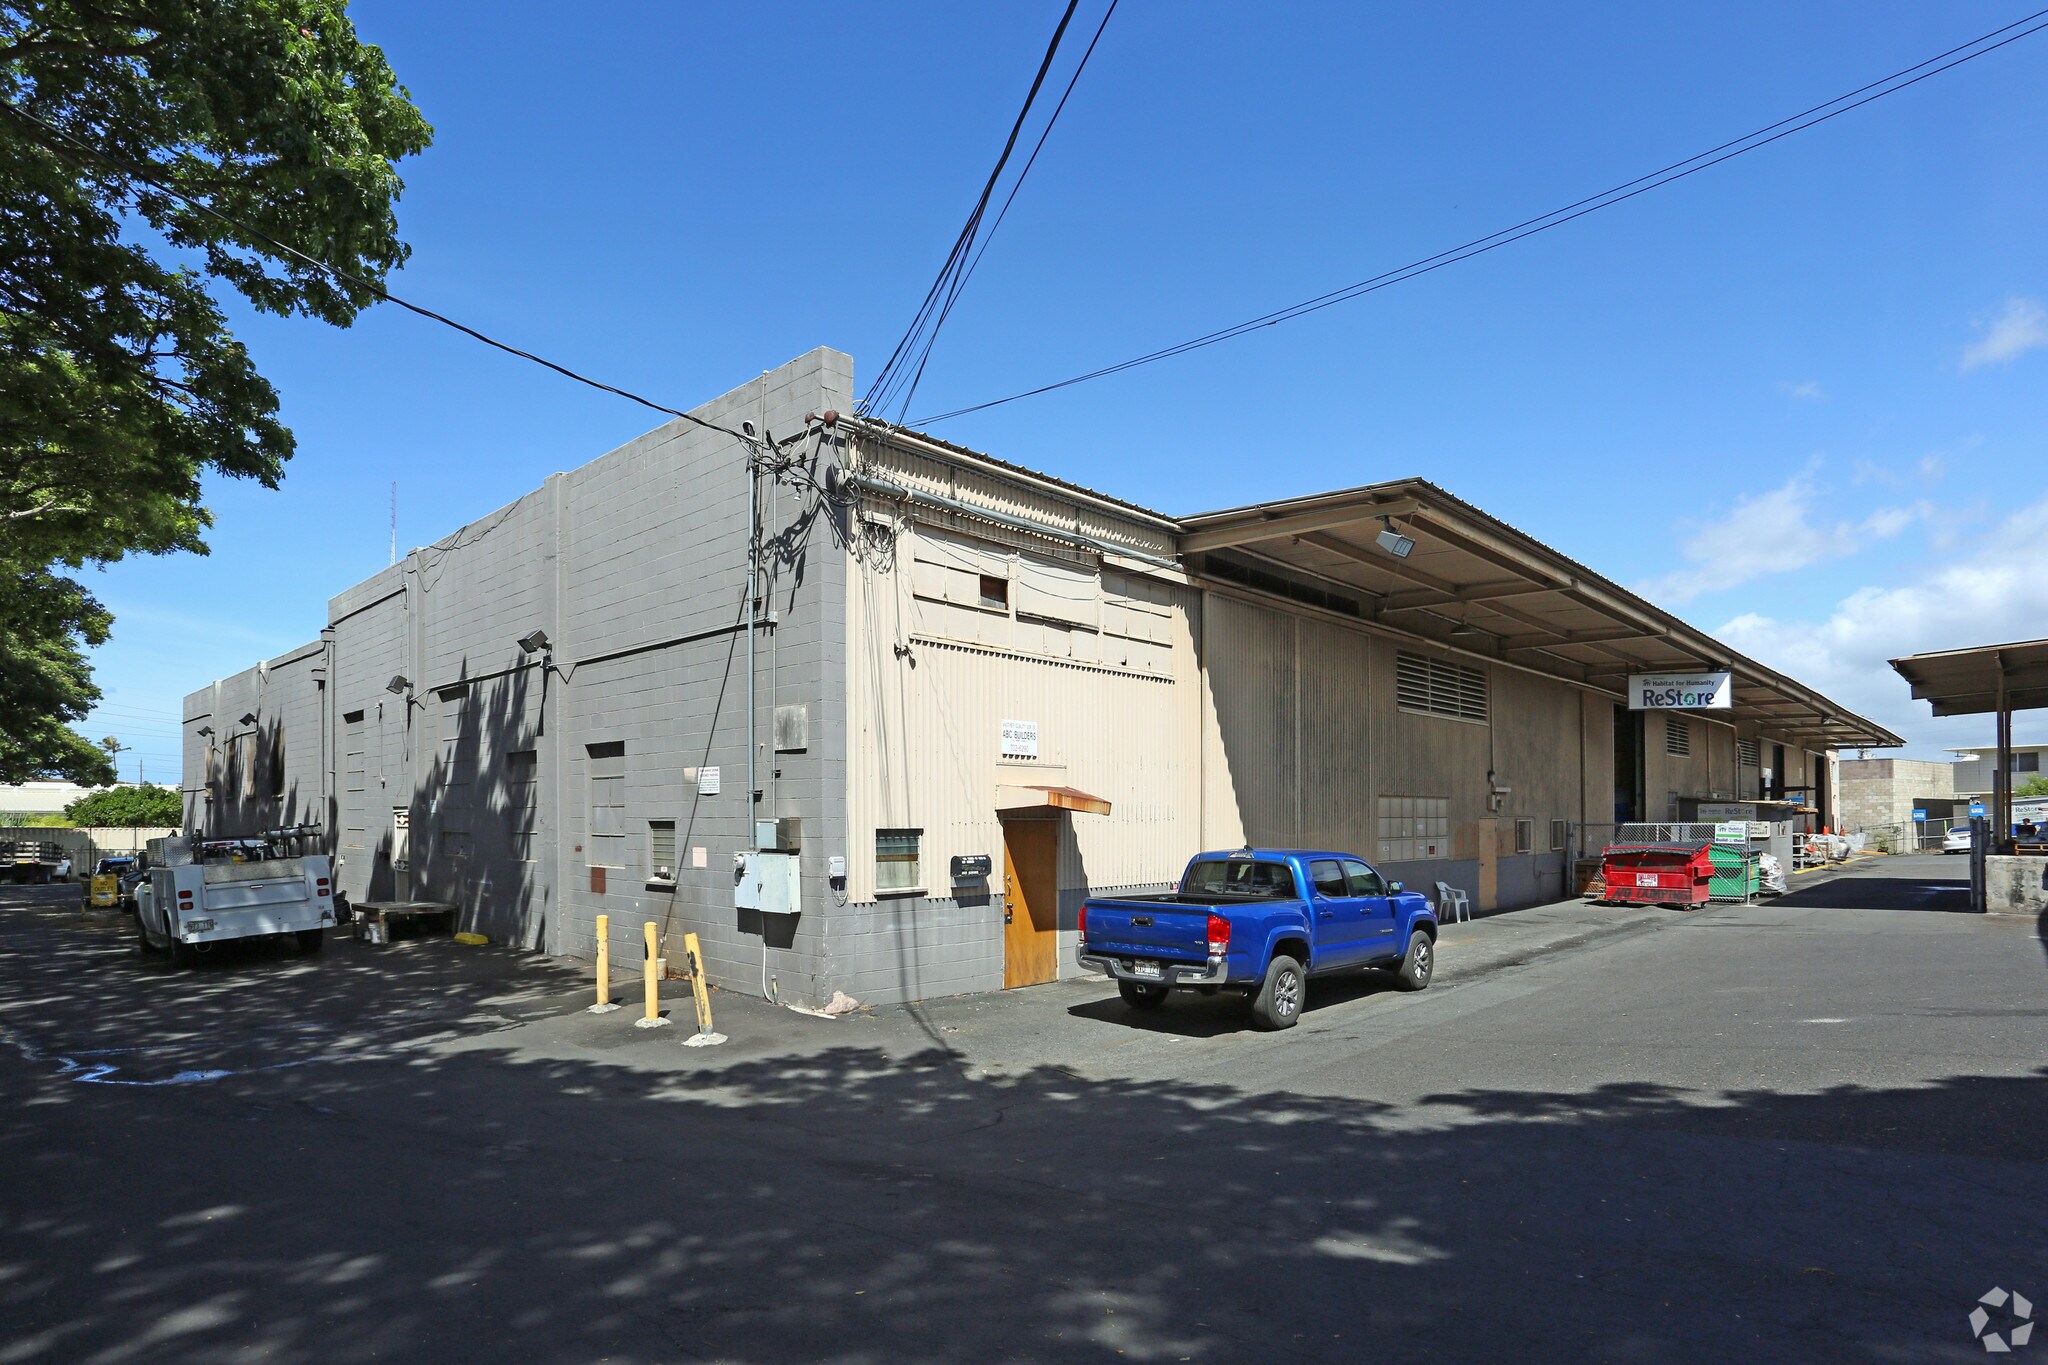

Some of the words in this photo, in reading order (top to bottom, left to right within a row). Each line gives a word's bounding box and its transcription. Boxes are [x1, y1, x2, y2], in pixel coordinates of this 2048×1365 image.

[1652, 679, 1674, 687] Habitat
[1686, 679, 1715, 687] Humanity
[1642, 688, 1715, 707] ReStore
[1003, 730, 1012, 738] ABC
[1014, 731, 1036, 740] BUILDERS
[1612, 888, 1632, 899] NO
